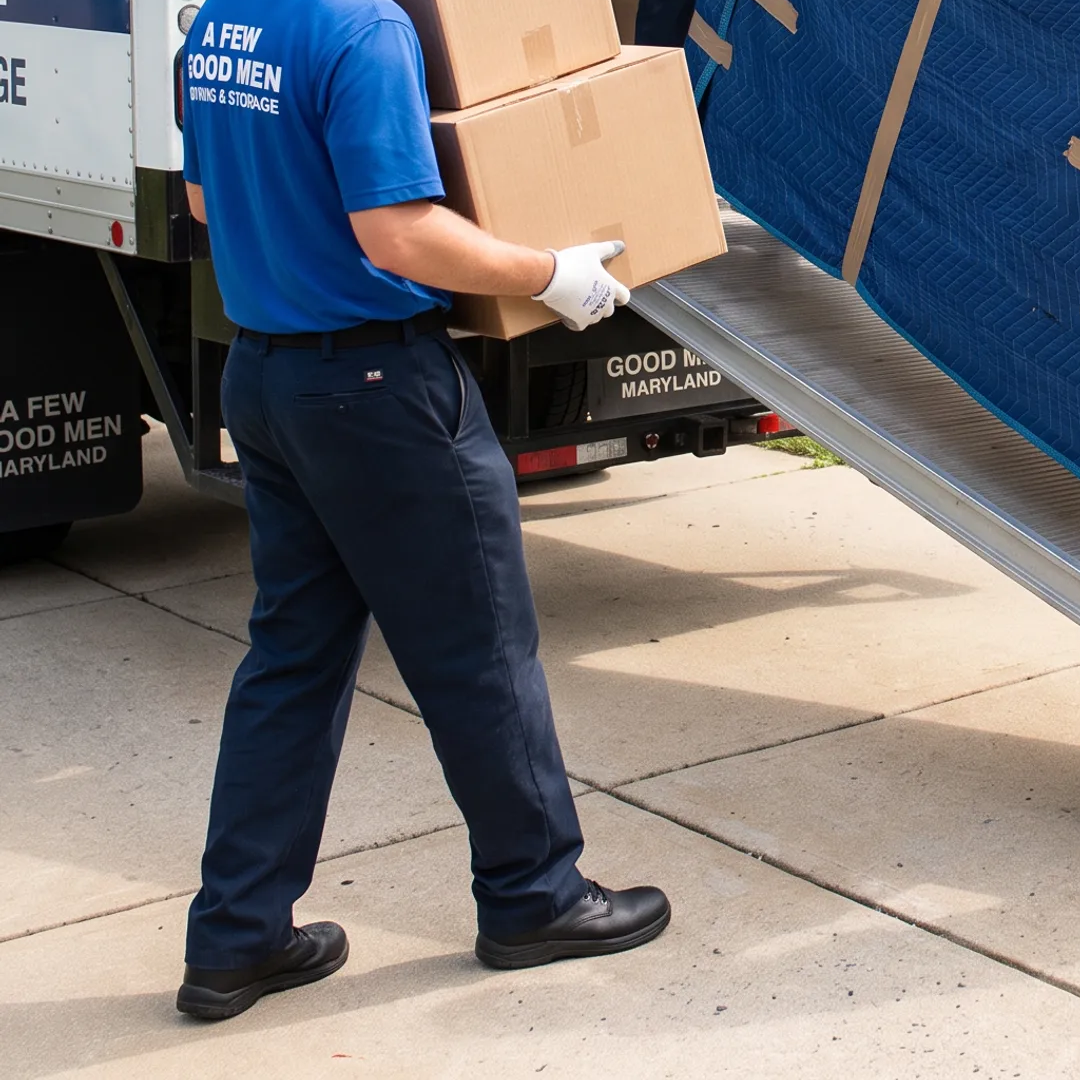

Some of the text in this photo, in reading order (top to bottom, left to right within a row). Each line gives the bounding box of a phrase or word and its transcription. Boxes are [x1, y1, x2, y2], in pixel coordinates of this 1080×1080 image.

[202, 21, 263, 53] A FEW
[236, 58, 282, 93] MEN
[218, 88, 226, 105] &
[228, 90, 280, 115] STORAGE
[606, 349, 677, 378] GOOD
[621, 370, 722, 399] MARYLAND
[0, 391, 87, 423] A FEW
[64, 414, 122, 444] MEN
[0, 446, 107, 479] ARYLAND
